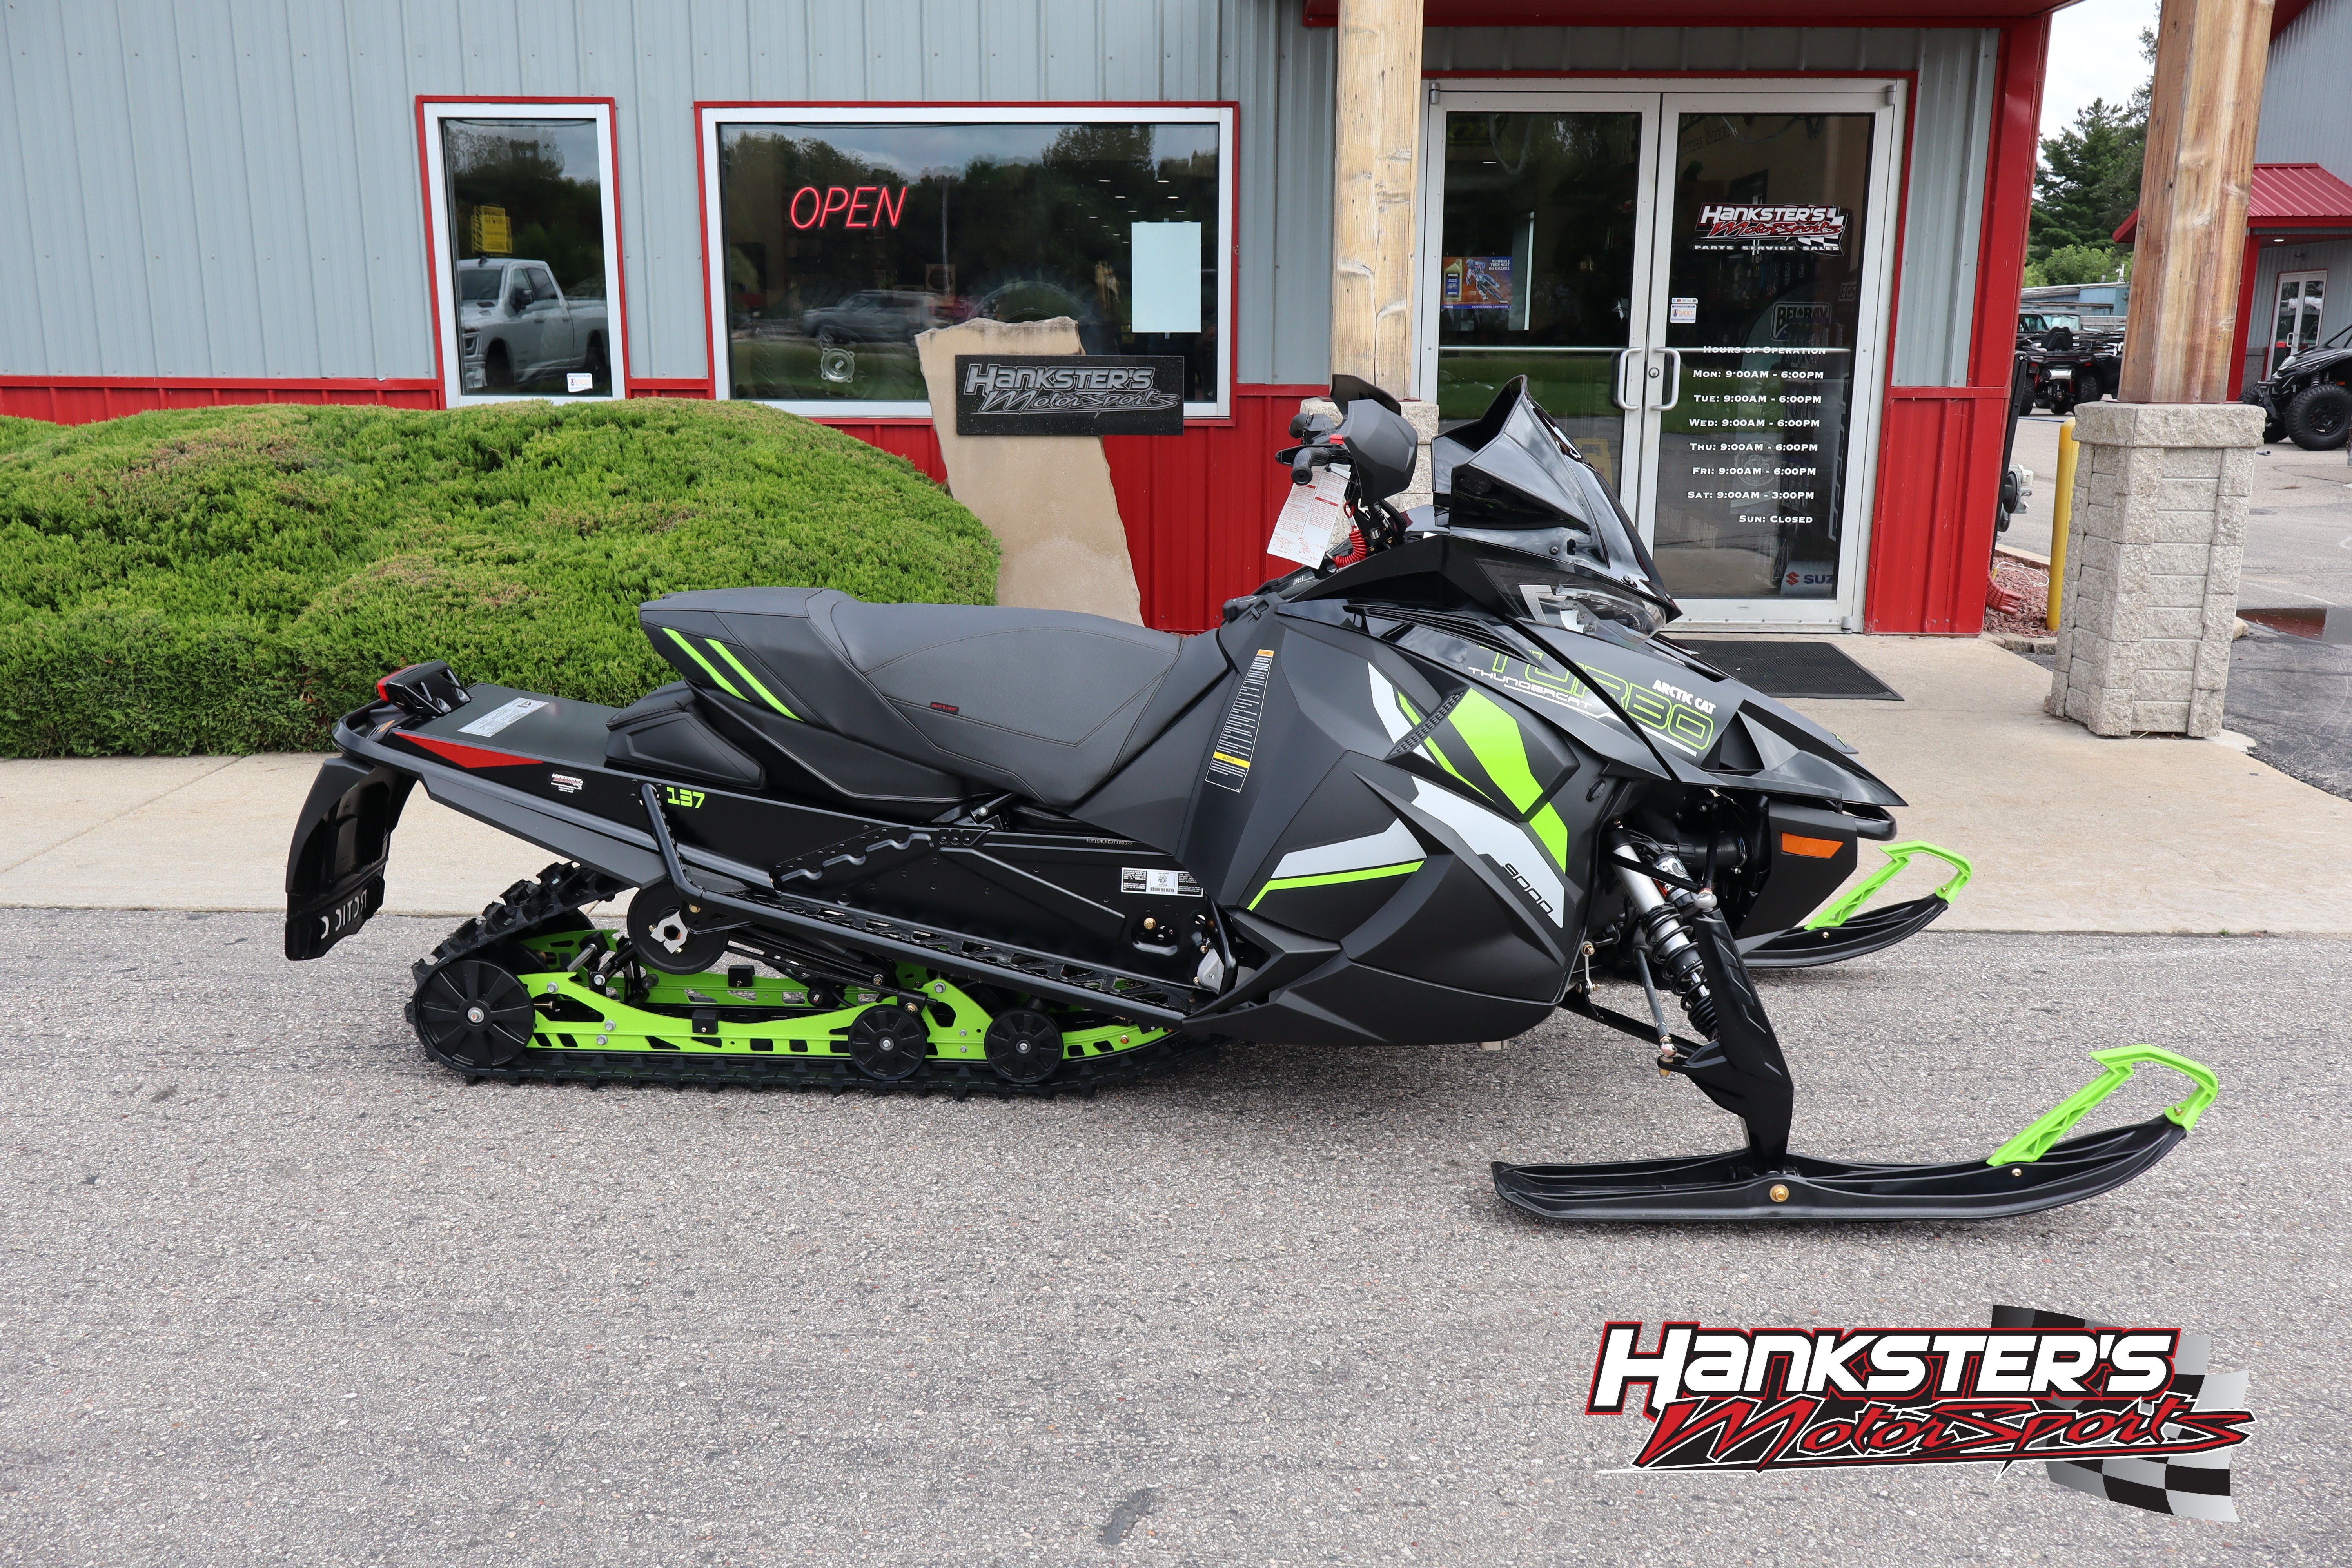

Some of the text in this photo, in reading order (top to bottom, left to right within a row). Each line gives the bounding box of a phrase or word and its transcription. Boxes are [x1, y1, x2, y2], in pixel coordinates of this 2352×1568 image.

[789, 185, 908, 230] OPEN
[1468, 666, 1592, 710] THUNDERCAT
[1653, 679, 1716, 715] ARCTIC CAT
[667, 786, 705, 808] 137
